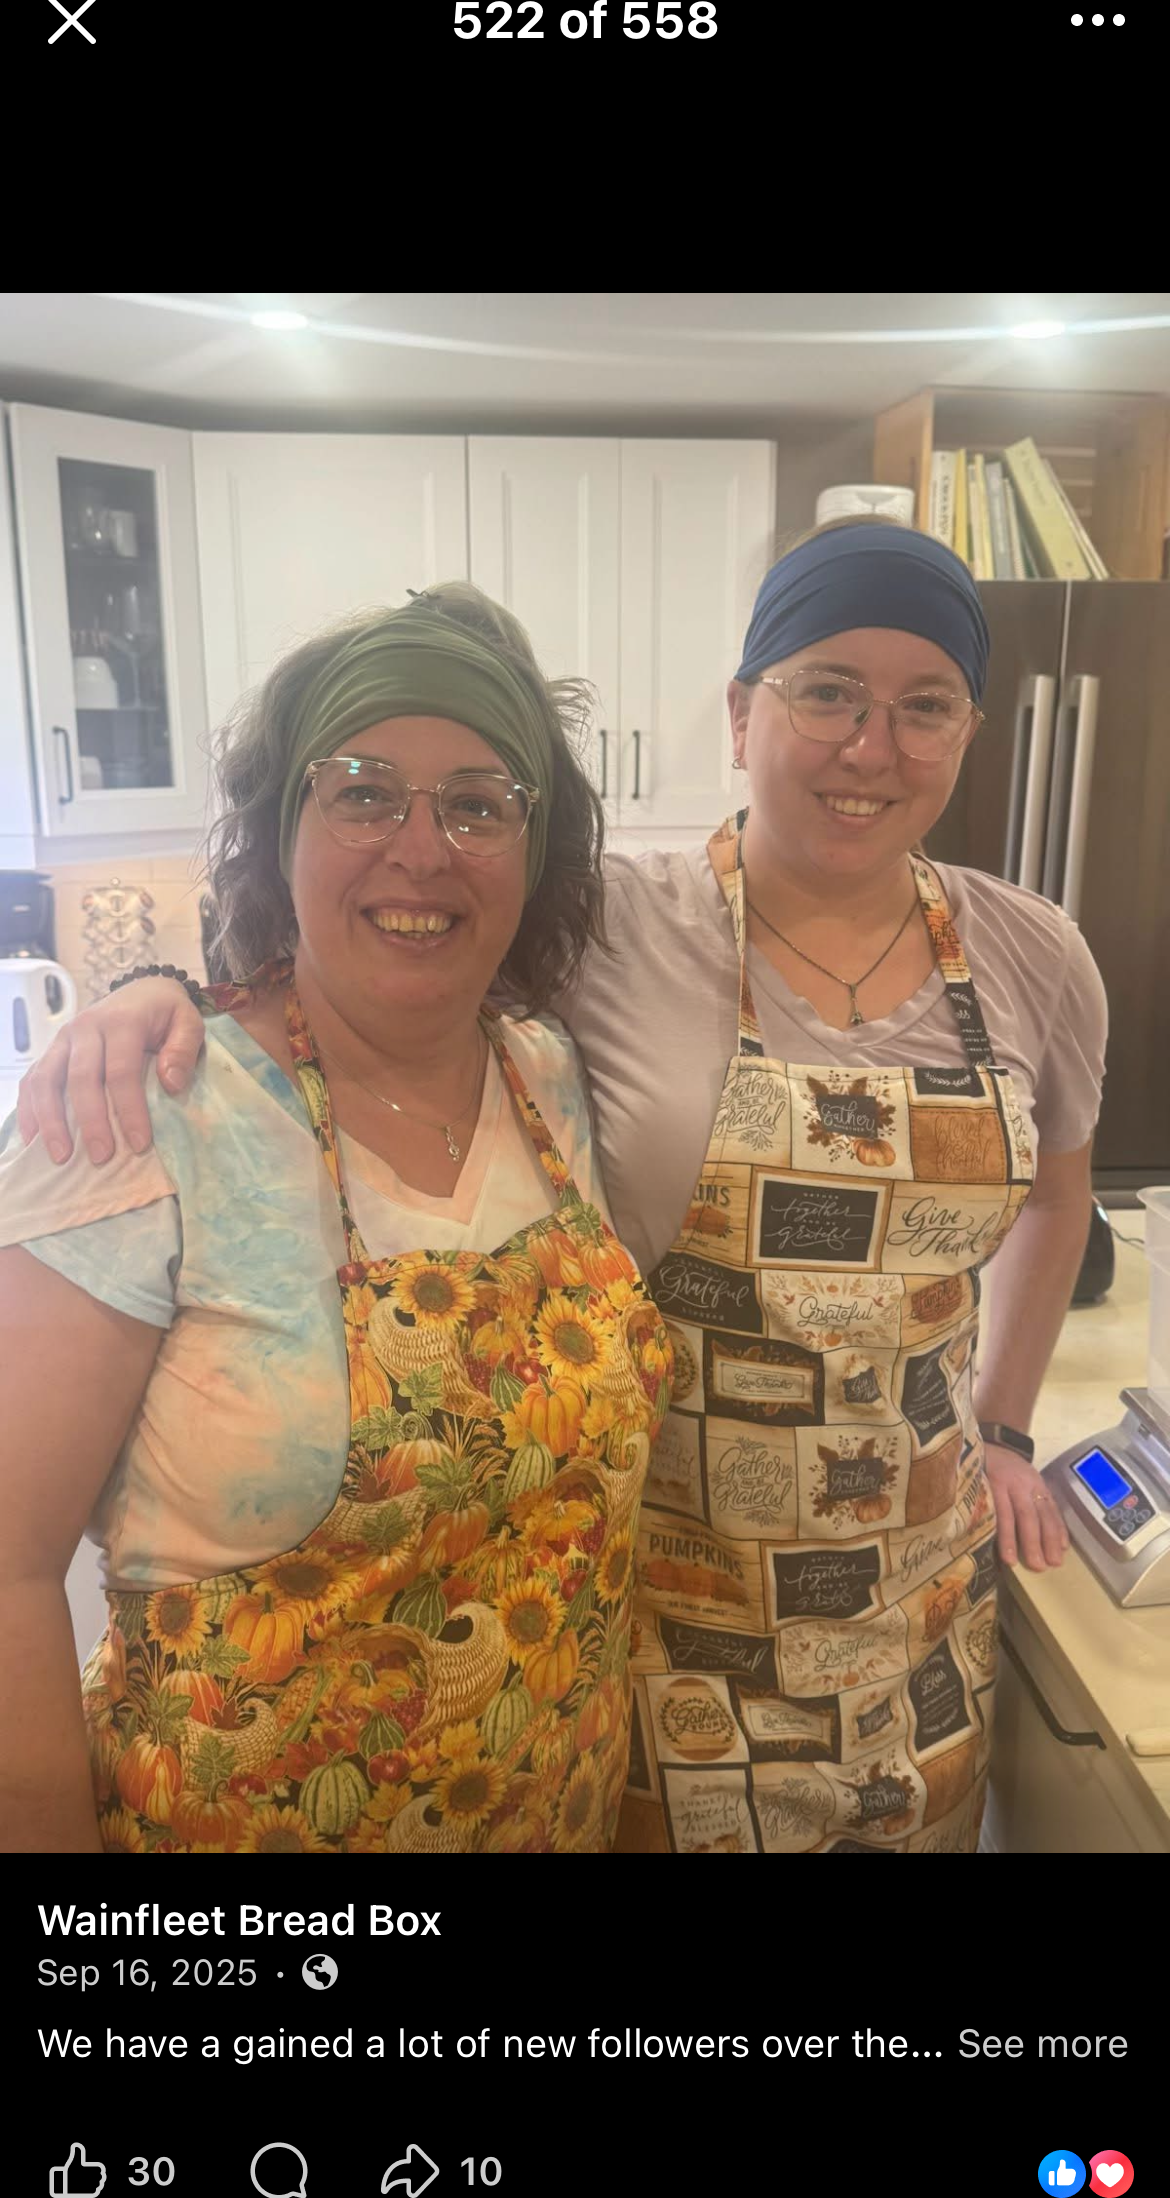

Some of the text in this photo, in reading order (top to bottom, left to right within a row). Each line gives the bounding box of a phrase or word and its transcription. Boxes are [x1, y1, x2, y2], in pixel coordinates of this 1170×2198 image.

[887, 1196, 974, 1246] Give
[655, 1265, 750, 1308] Grateful
[797, 1296, 873, 1327] Grateful
[718, 1446, 782, 1485] Gather
[712, 1480, 792, 1514] grateful
[649, 1533, 744, 1580] PUMPKINS
